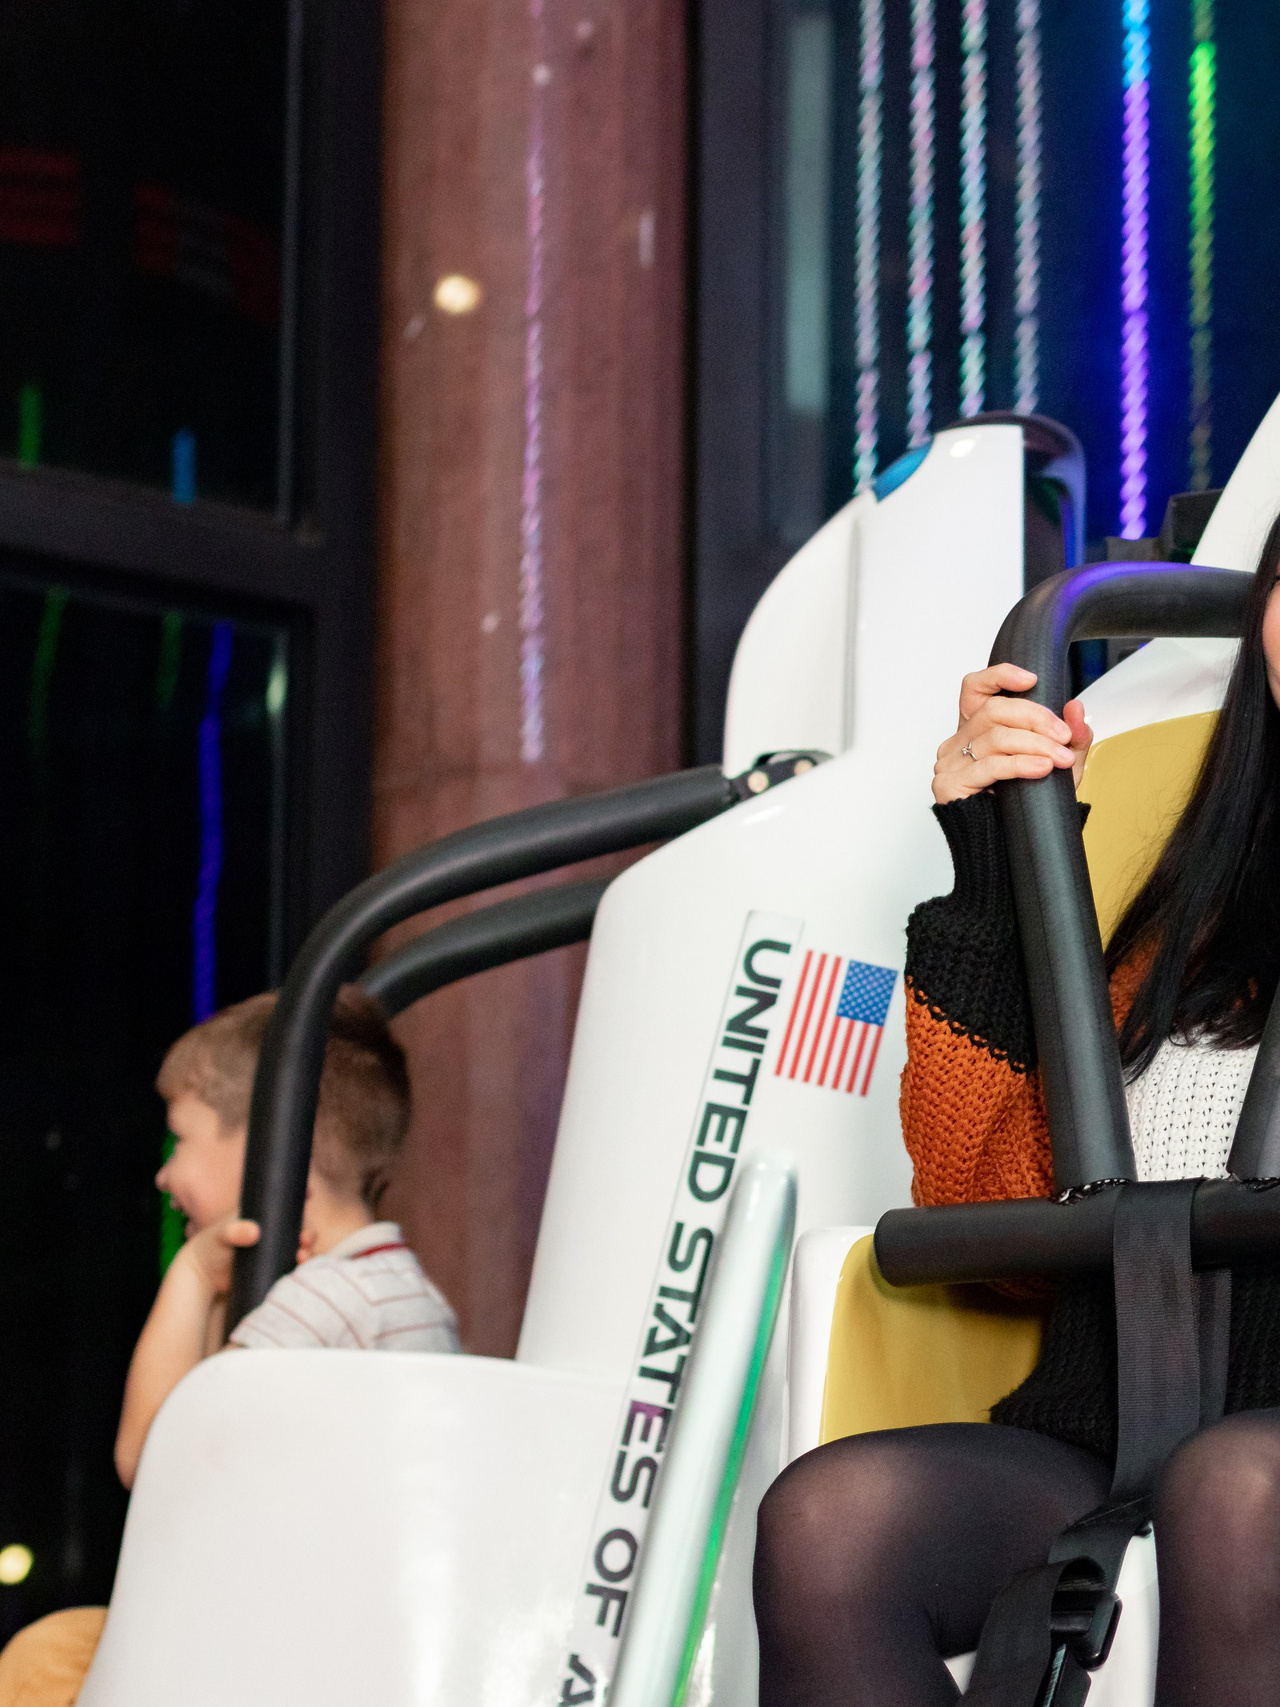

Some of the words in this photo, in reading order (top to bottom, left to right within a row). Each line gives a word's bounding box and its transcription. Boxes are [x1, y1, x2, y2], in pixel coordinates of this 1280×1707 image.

[686, 938, 792, 1204] UNITED
[609, 1221, 715, 1509] STATES
[585, 1527, 639, 1638] OF
